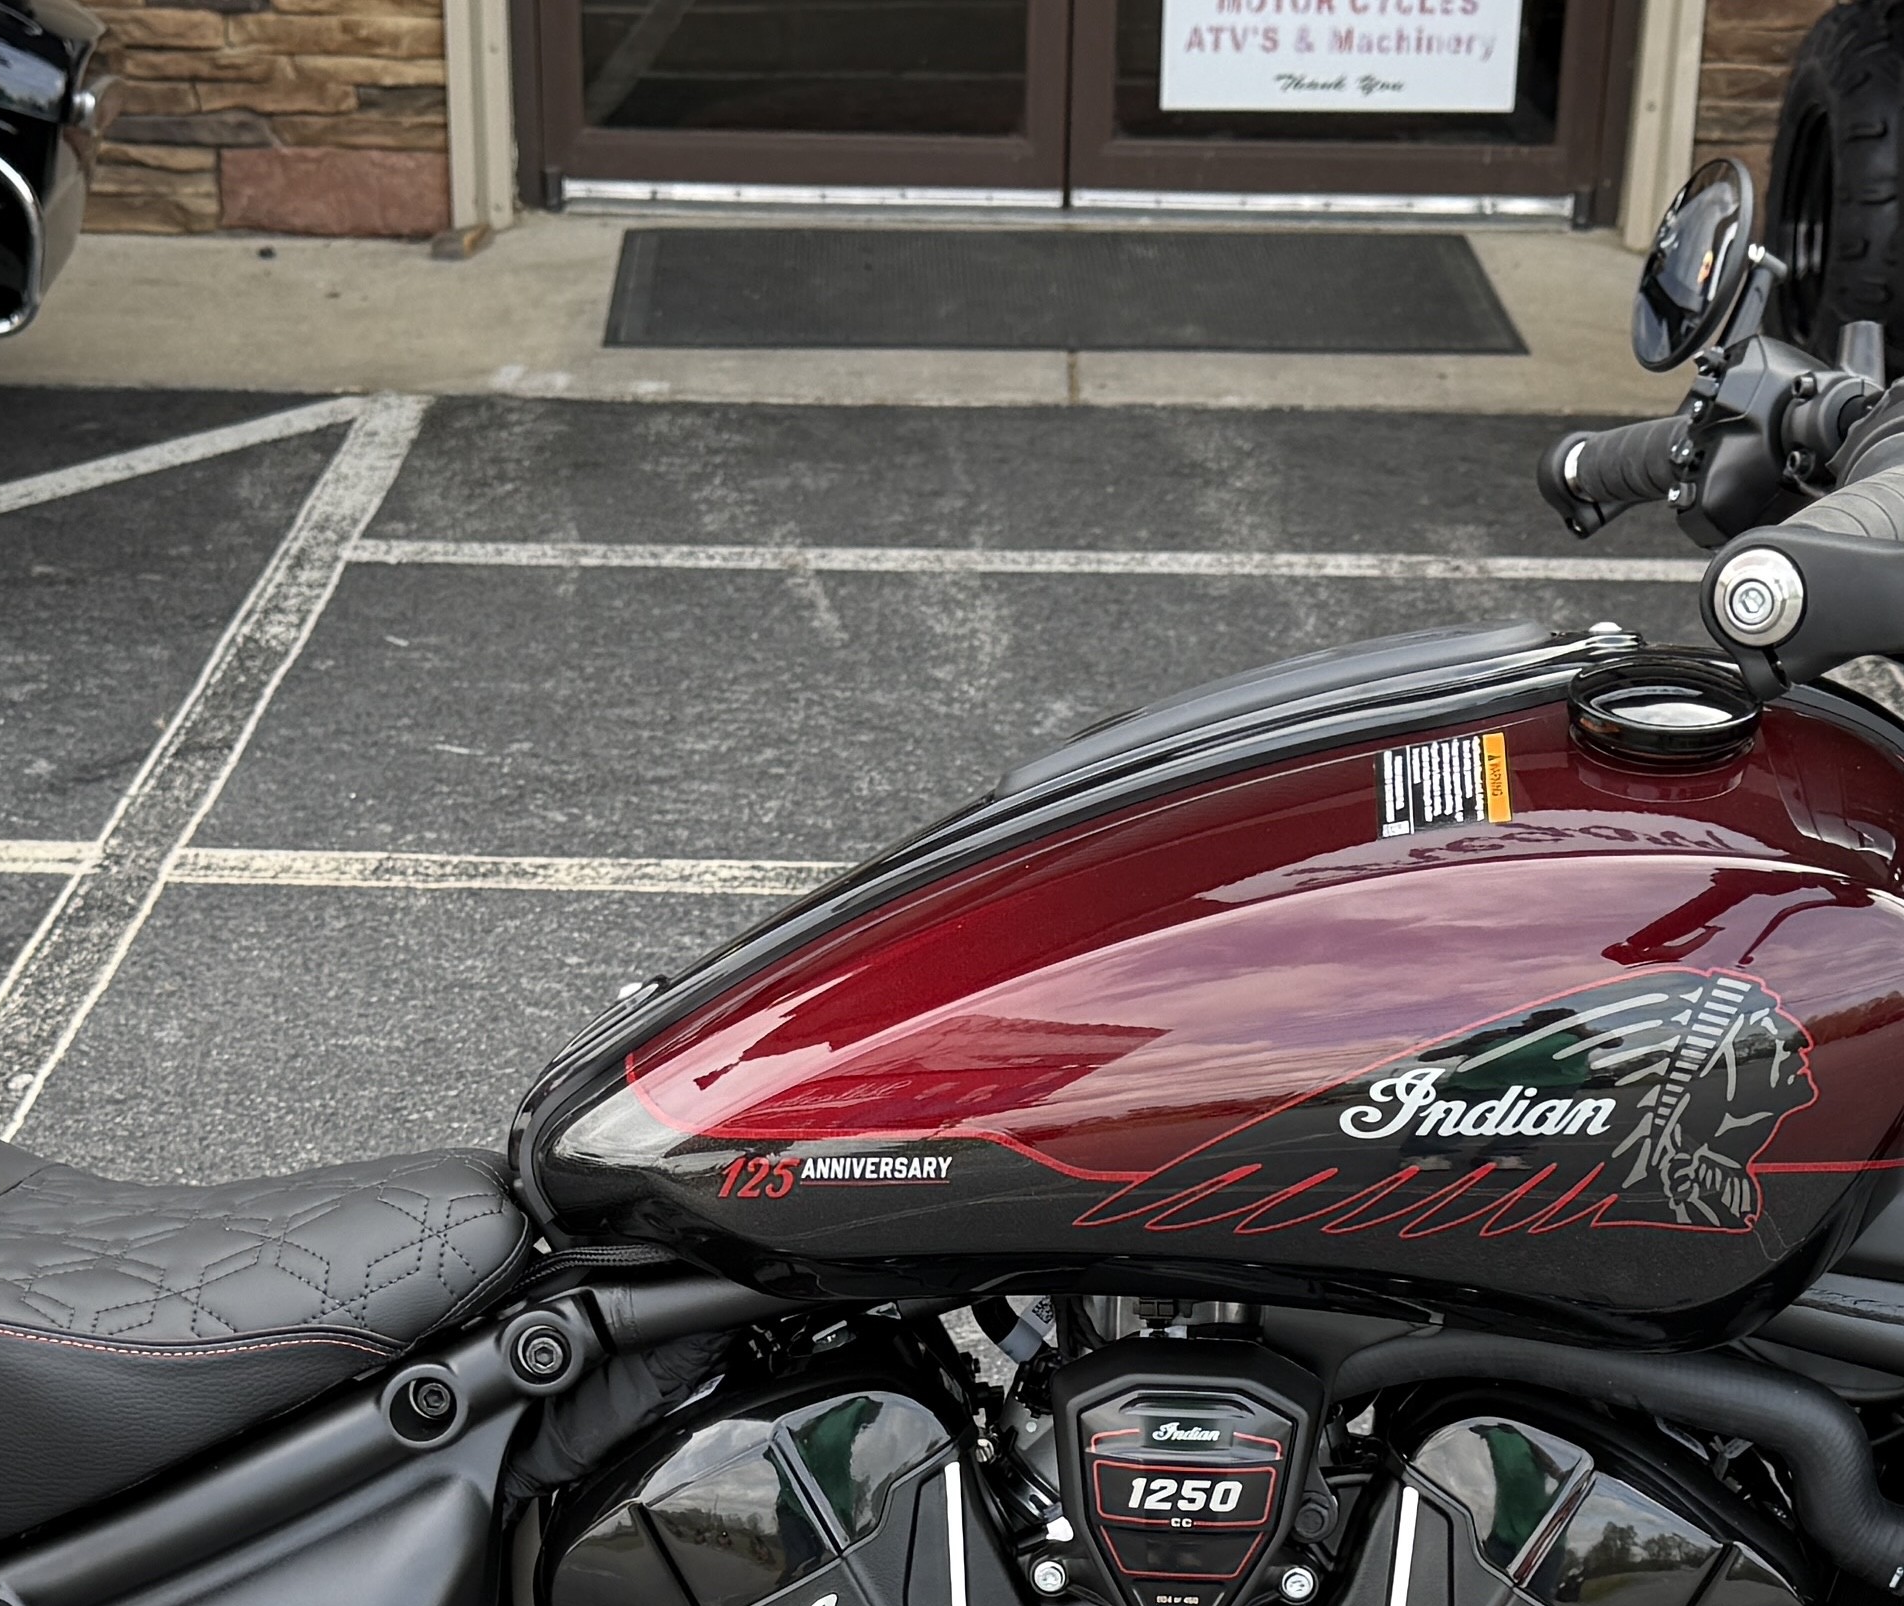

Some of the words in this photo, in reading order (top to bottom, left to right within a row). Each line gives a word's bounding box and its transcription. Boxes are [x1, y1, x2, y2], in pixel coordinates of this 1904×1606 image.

[1184, 25, 1279, 54] ATV'S
[1294, 27, 1314, 54] &
[1328, 26, 1498, 61] Machinery
[1274, 72, 1347, 92] Thank
[1356, 73, 1406, 97] You
[1338, 1066, 1618, 1141] Indian
[717, 1155, 801, 1200] 125
[800, 1155, 953, 1180] ANNIVERSARY
[1151, 1421, 1222, 1443] Indian
[1127, 1477, 1244, 1514] 1250
